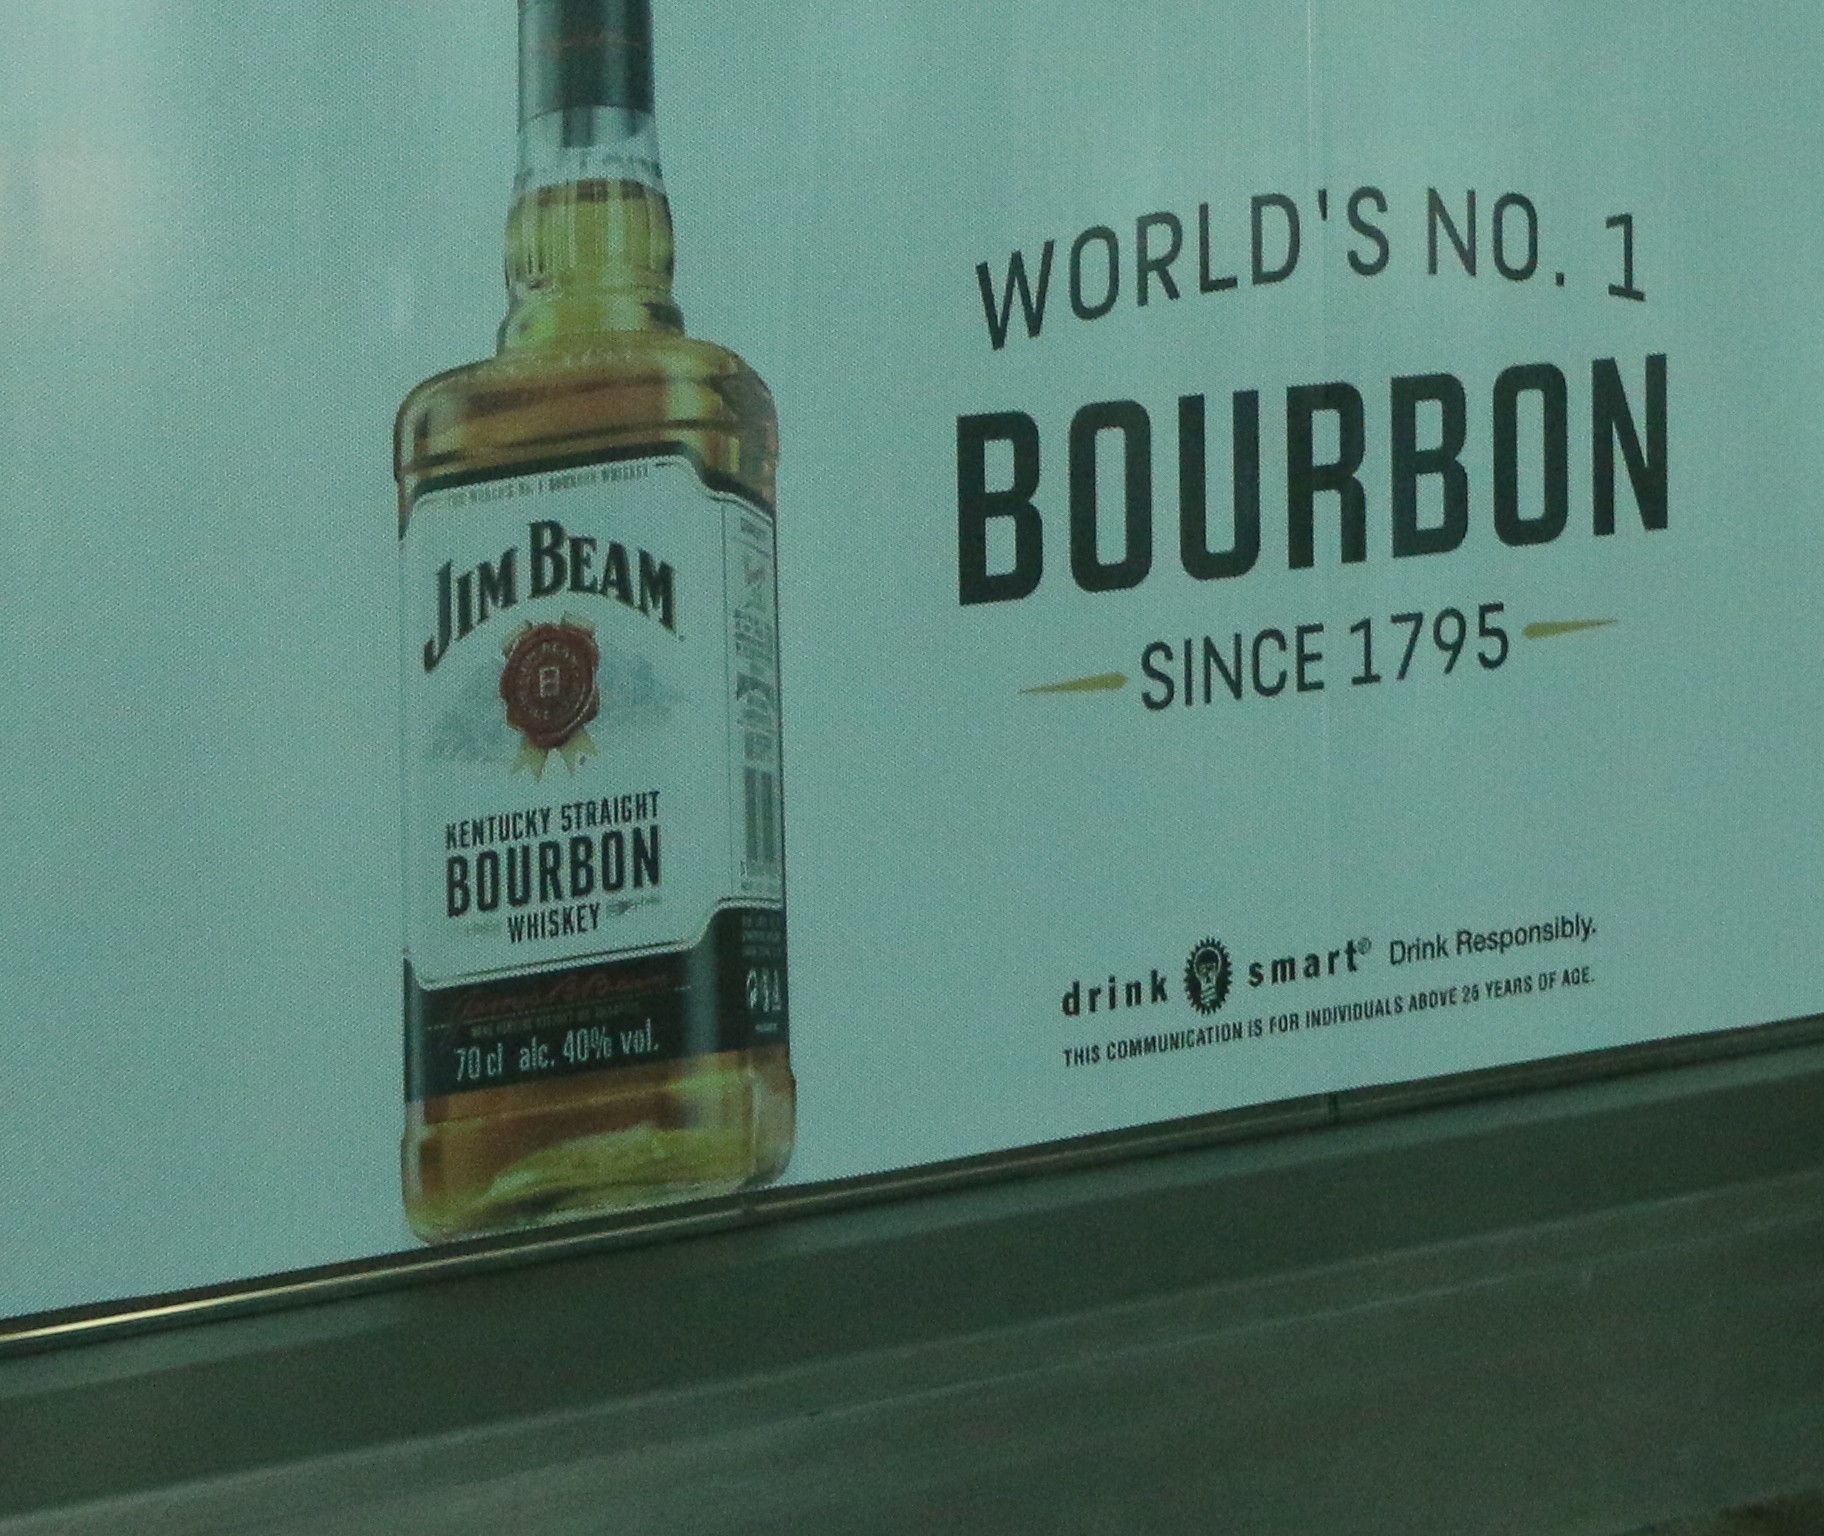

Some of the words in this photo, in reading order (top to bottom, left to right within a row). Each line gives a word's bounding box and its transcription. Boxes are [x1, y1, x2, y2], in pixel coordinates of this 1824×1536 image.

[975, 186, 1391, 351] WORLD'S
[1427, 186, 1566, 288] NO.
[1604, 212, 1646, 302] 1
[956, 353, 1669, 606] BOURBON
[423, 545, 518, 672] JIM
[527, 519, 677, 636] BEAM
[1140, 623, 1325, 711] SINCE
[1349, 602, 1511, 687] 1795
[446, 807, 551, 850] KENTUCKY
[561, 791, 660, 832] STRAIGHT
[447, 824, 660, 919] BOURBON
[507, 902, 600, 943] WHISKEY
[1062, 968, 1168, 1016] drink
[1390, 934, 1449, 965] Drink
[1456, 912, 1597, 955] Responsibly.
[453, 1045, 481, 1082] 70
[487, 1042, 502, 1076] cl
[519, 1035, 555, 1071] alc.
[563, 1026, 613, 1064] 40%
[620, 1017, 659, 1055] vol.
[1064, 1045, 1100, 1067] THIS
[1106, 1021, 1243, 1061] COMMUNICATION
[1248, 1018, 1262, 1038] IS
[1270, 1013, 1299, 1034] FOR
[1306, 996, 1403, 1029] INDIVIDUALS
[1409, 987, 1457, 1013] ABOVE
[1486, 974, 1533, 999] YEARS
[1538, 970, 1556, 991] OF
